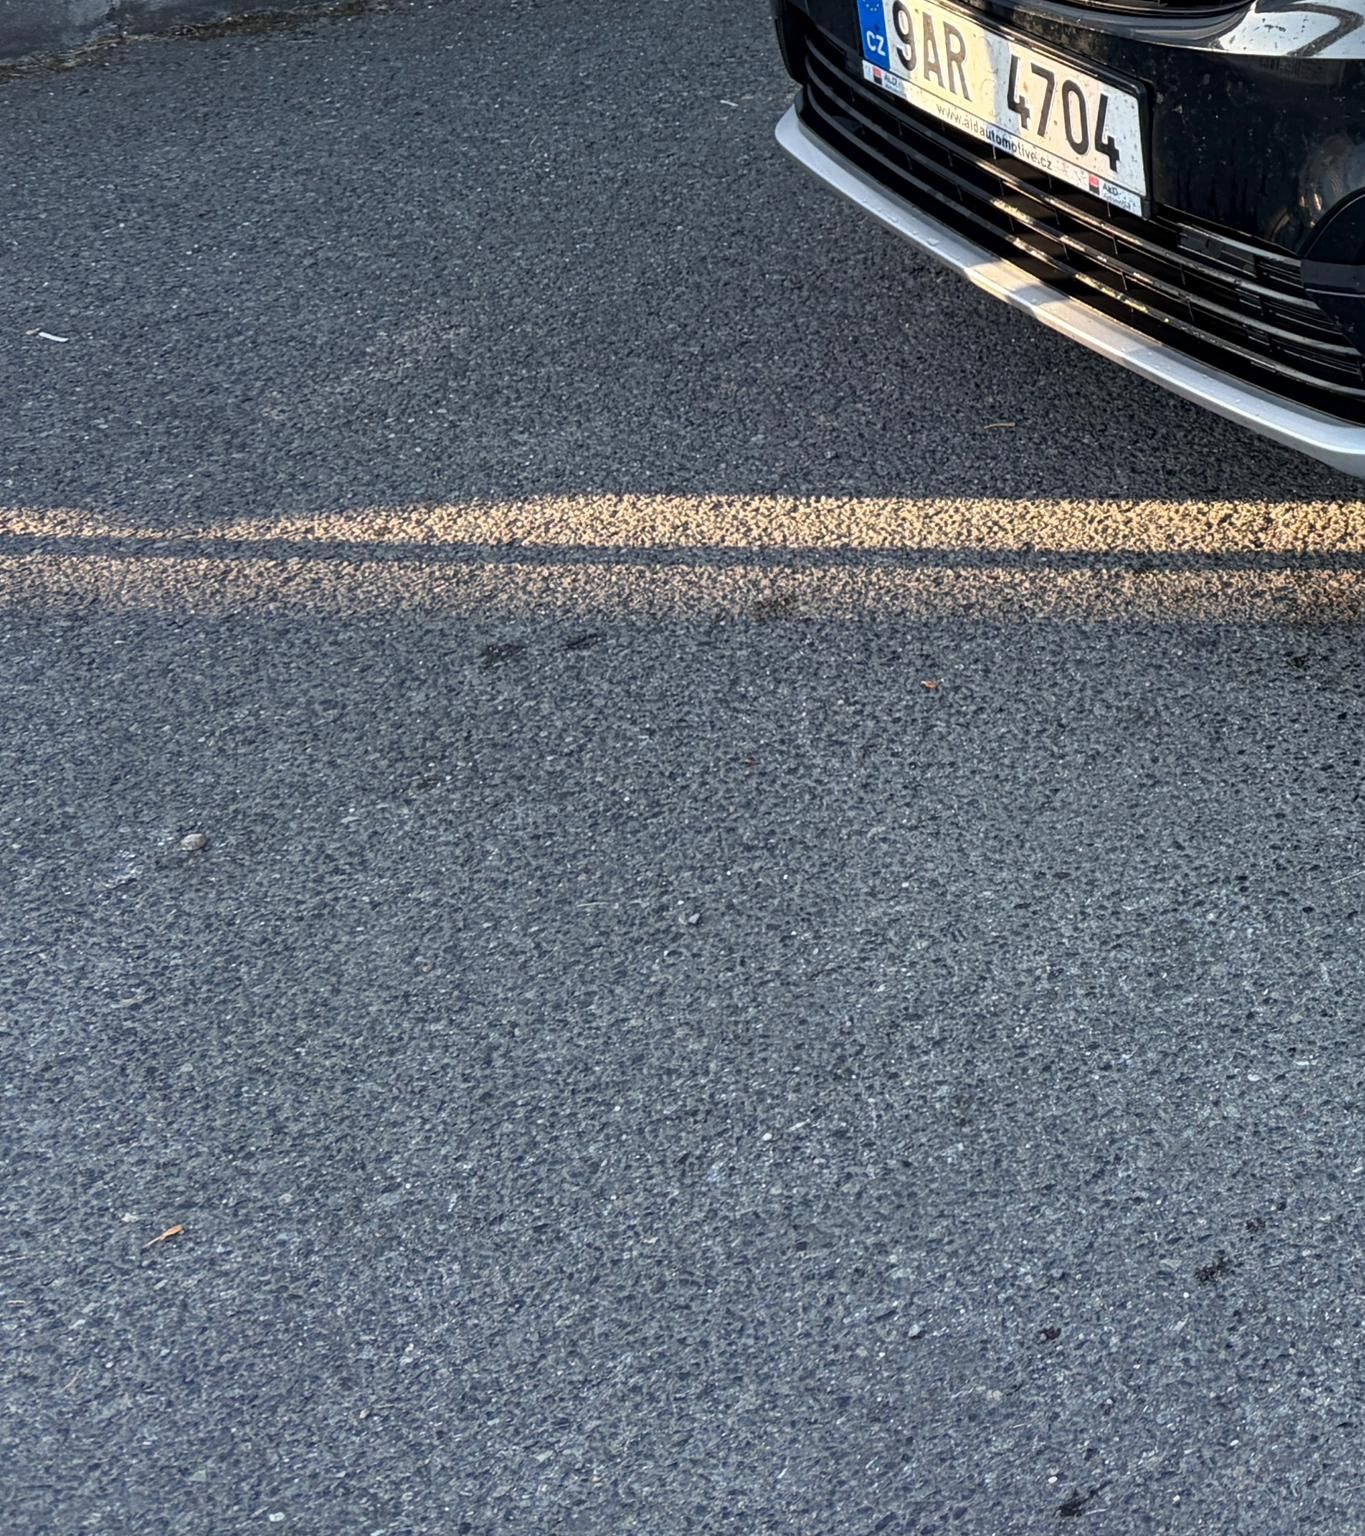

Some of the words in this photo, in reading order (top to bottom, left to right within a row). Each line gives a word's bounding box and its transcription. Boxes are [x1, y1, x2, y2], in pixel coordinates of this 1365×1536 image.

[866, 30, 886, 57] CZ
[891, 0, 973, 102] 9AR
[1007, 54, 1121, 172] 4704
